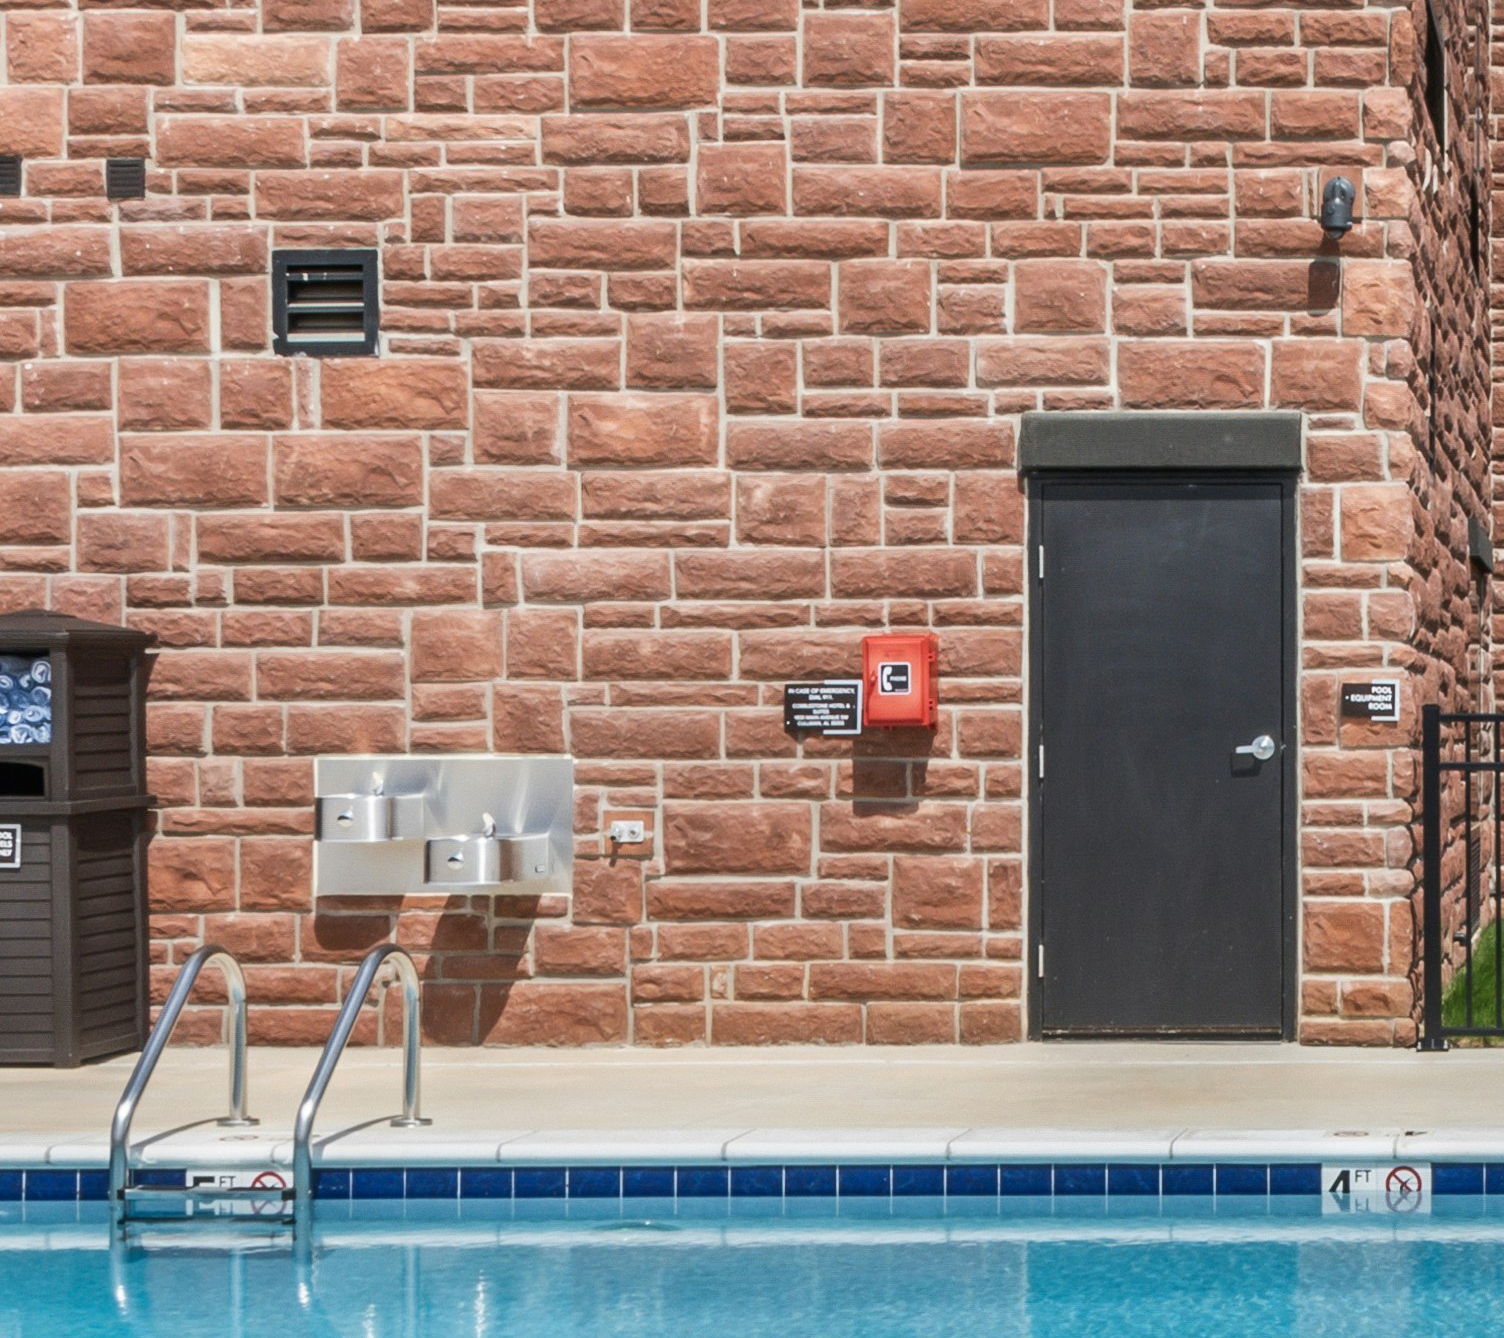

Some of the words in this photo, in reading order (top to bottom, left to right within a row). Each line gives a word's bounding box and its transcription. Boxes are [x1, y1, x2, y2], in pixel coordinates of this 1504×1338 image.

[1371, 686, 1393, 694] POOL
[1350, 694, 1393, 702] EQUIPMENT
[1368, 702, 1393, 710] ROOM
[1354, 1169, 1371, 1183] FT
